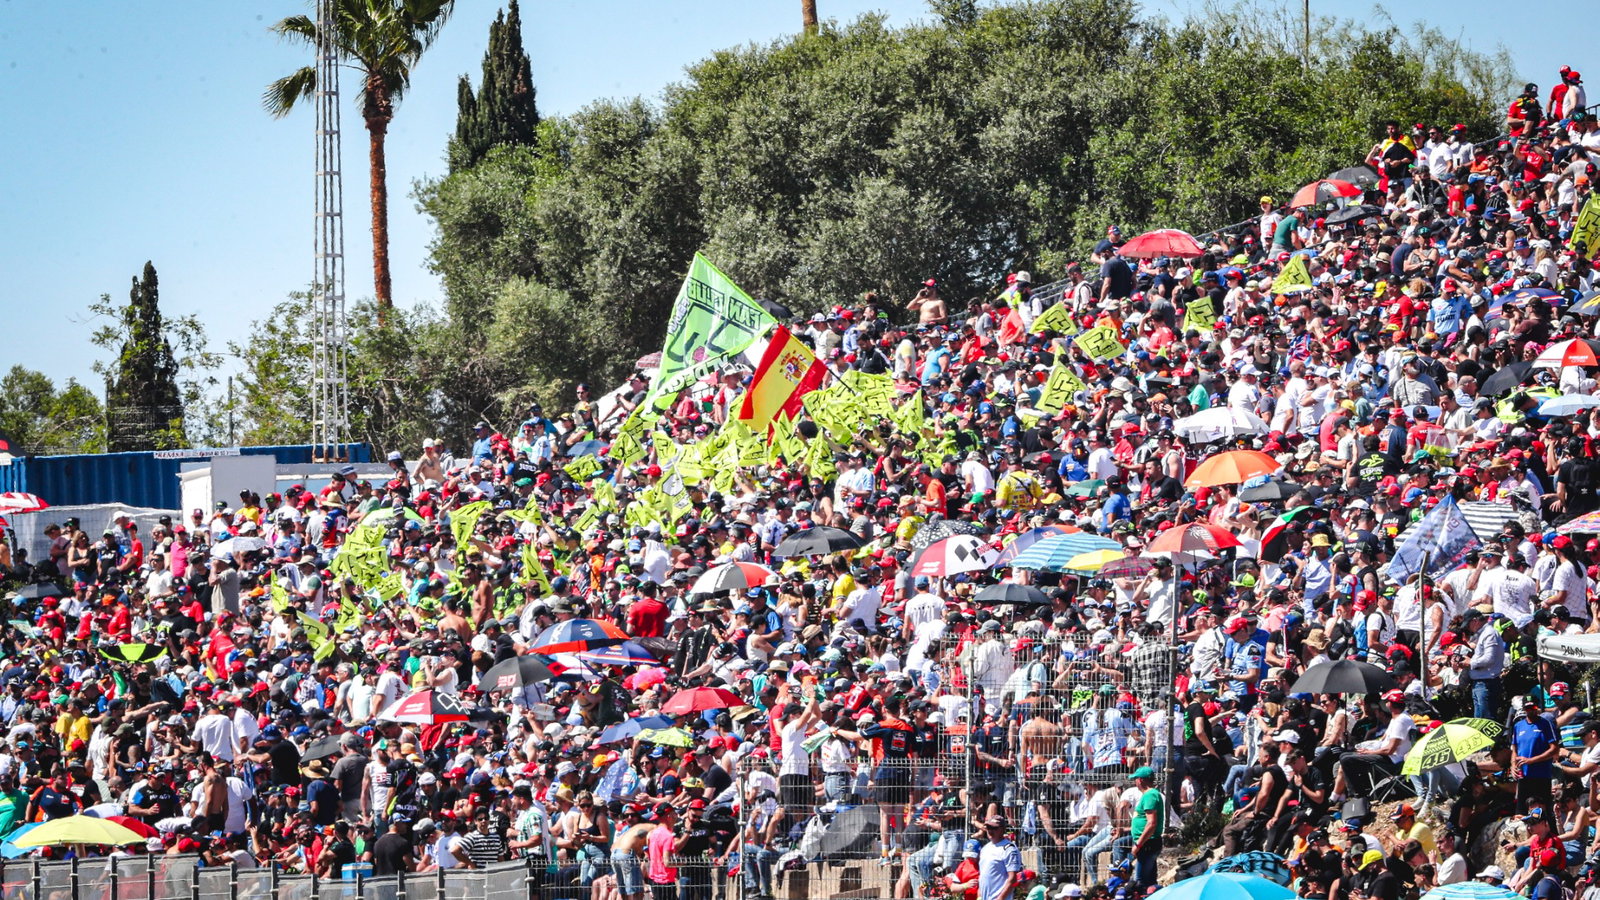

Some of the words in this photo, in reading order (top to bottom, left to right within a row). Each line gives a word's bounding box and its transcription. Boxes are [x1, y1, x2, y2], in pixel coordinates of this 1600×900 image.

[1482, 721, 1503, 739] 46
[1455, 733, 1483, 756] 46
[1422, 747, 1451, 770] 46
